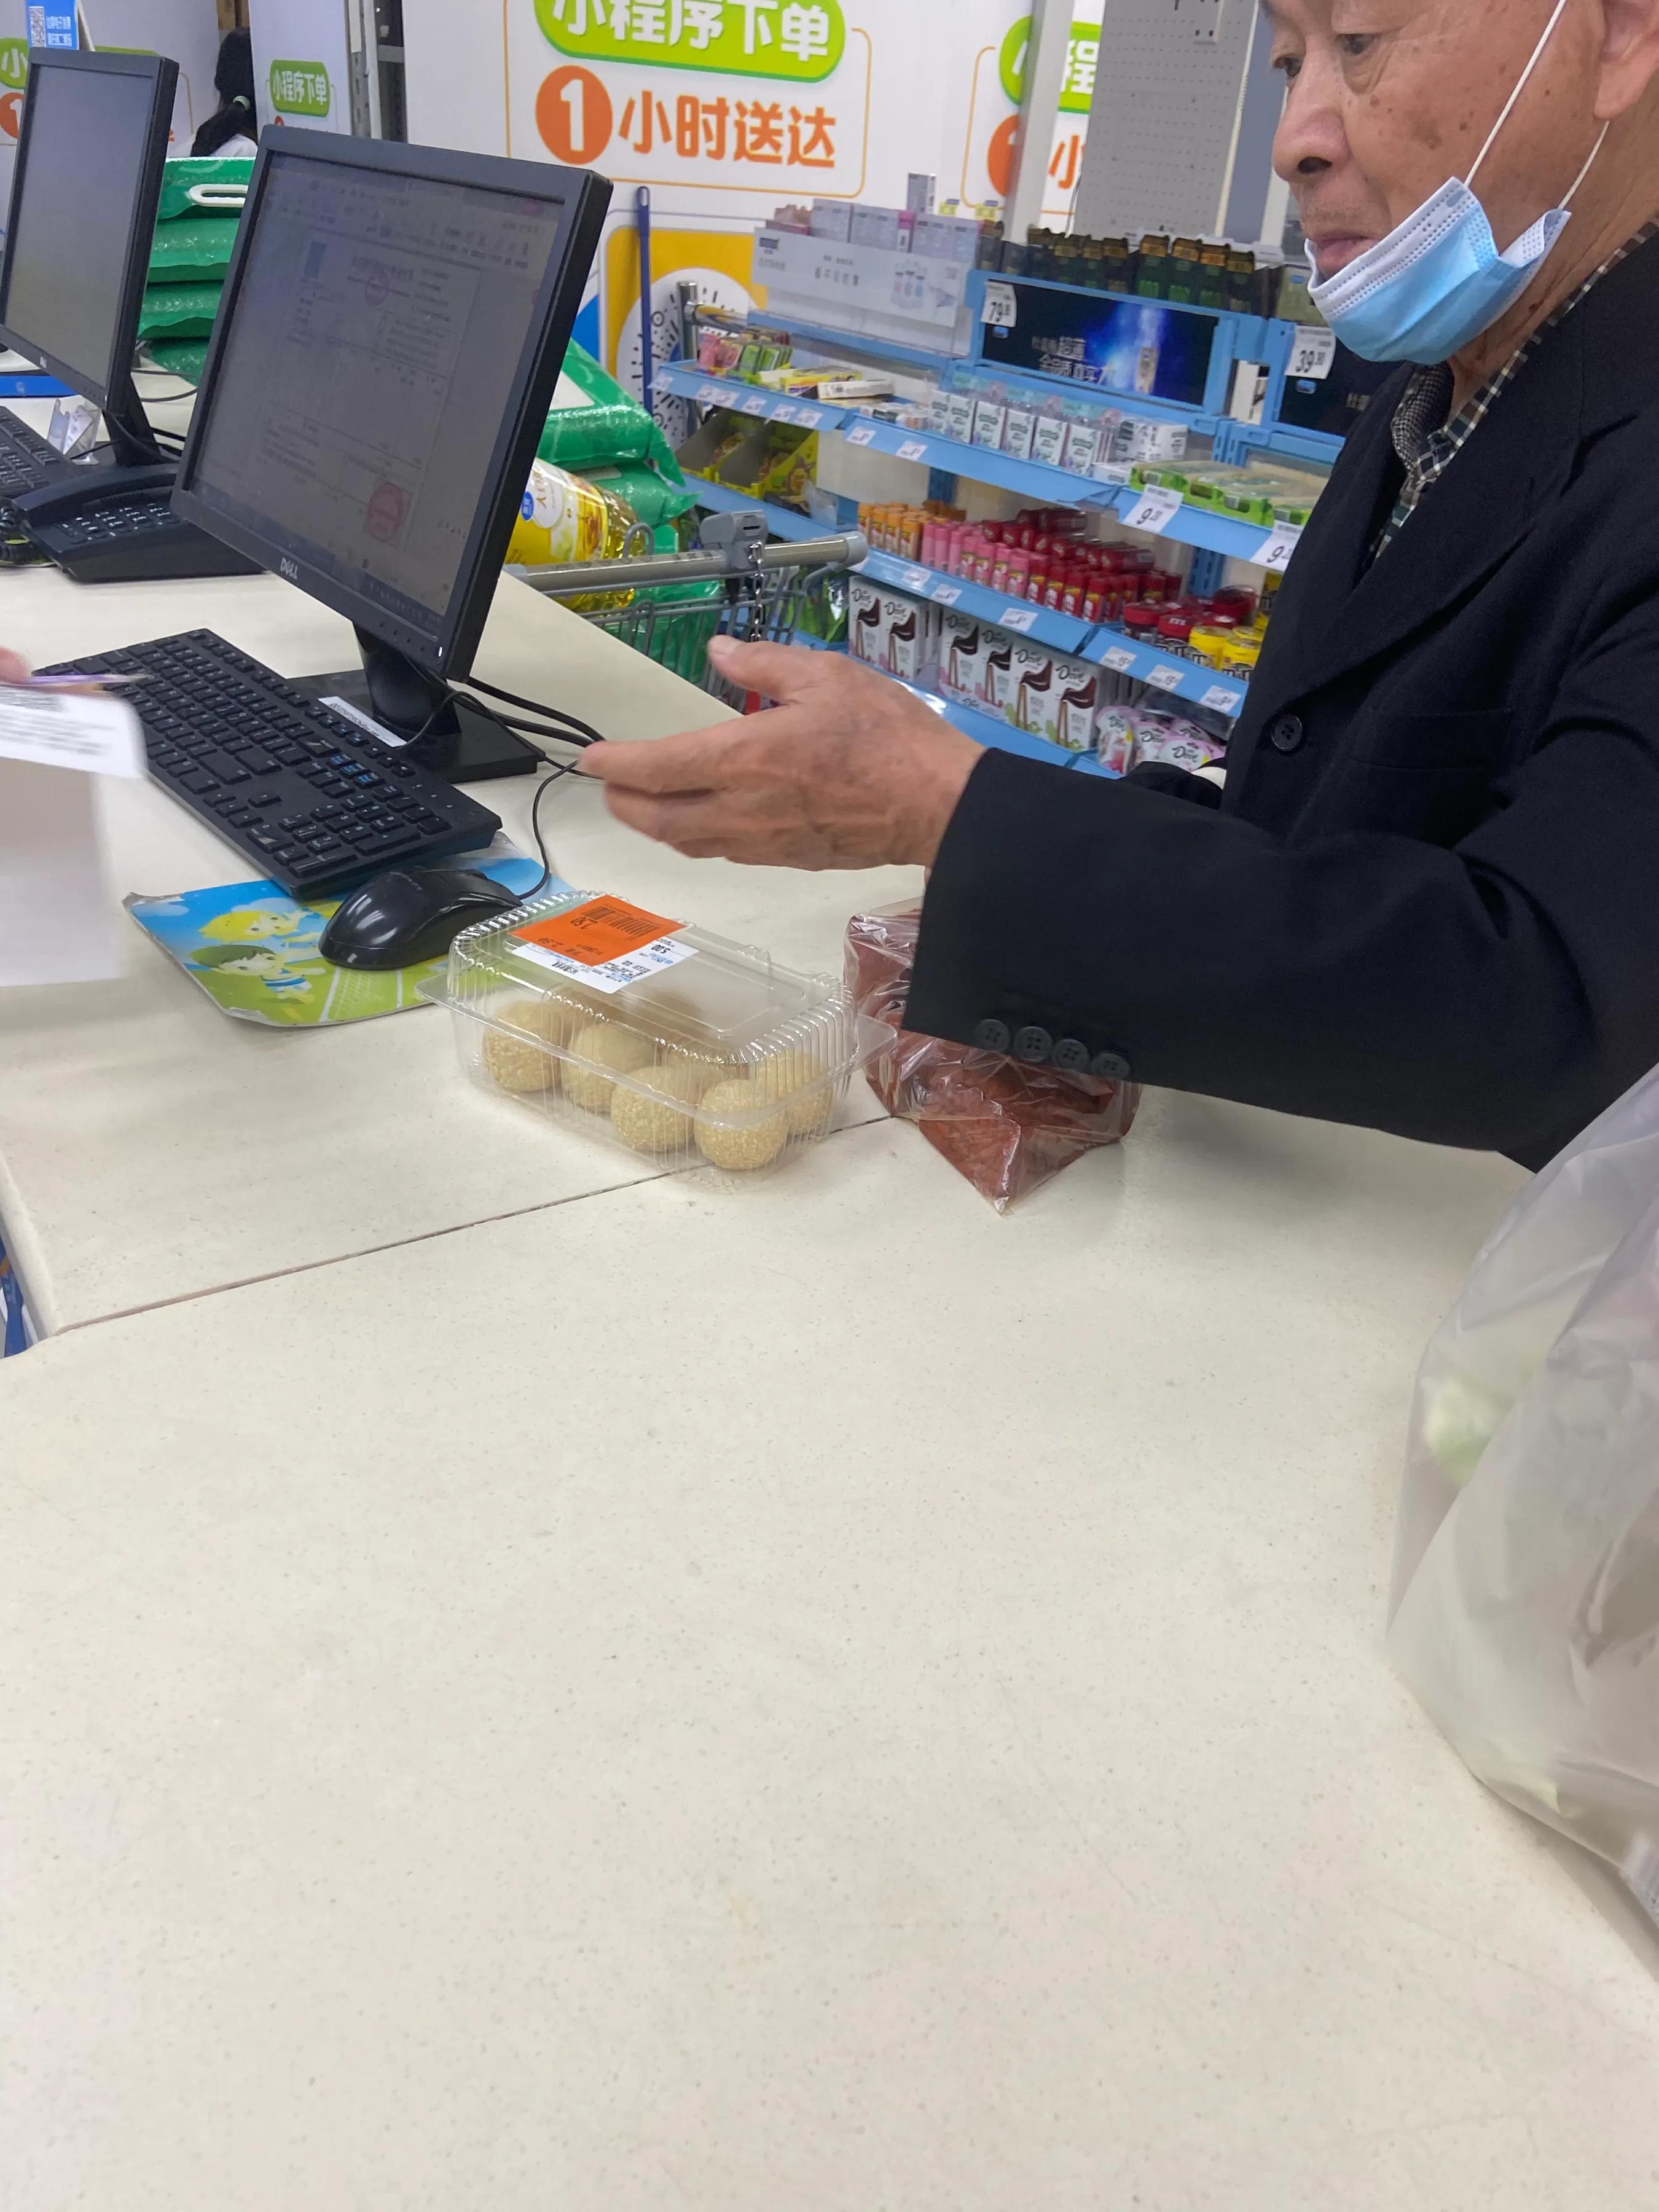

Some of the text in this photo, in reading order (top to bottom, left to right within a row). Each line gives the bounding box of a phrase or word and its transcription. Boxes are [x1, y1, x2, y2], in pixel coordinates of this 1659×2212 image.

[552, 0, 830, 61] 小程序下单
[273, 69, 327, 106] 小程序下单
[280, 557, 298, 580] DELL
[651, 944, 671, 954] 5.00
